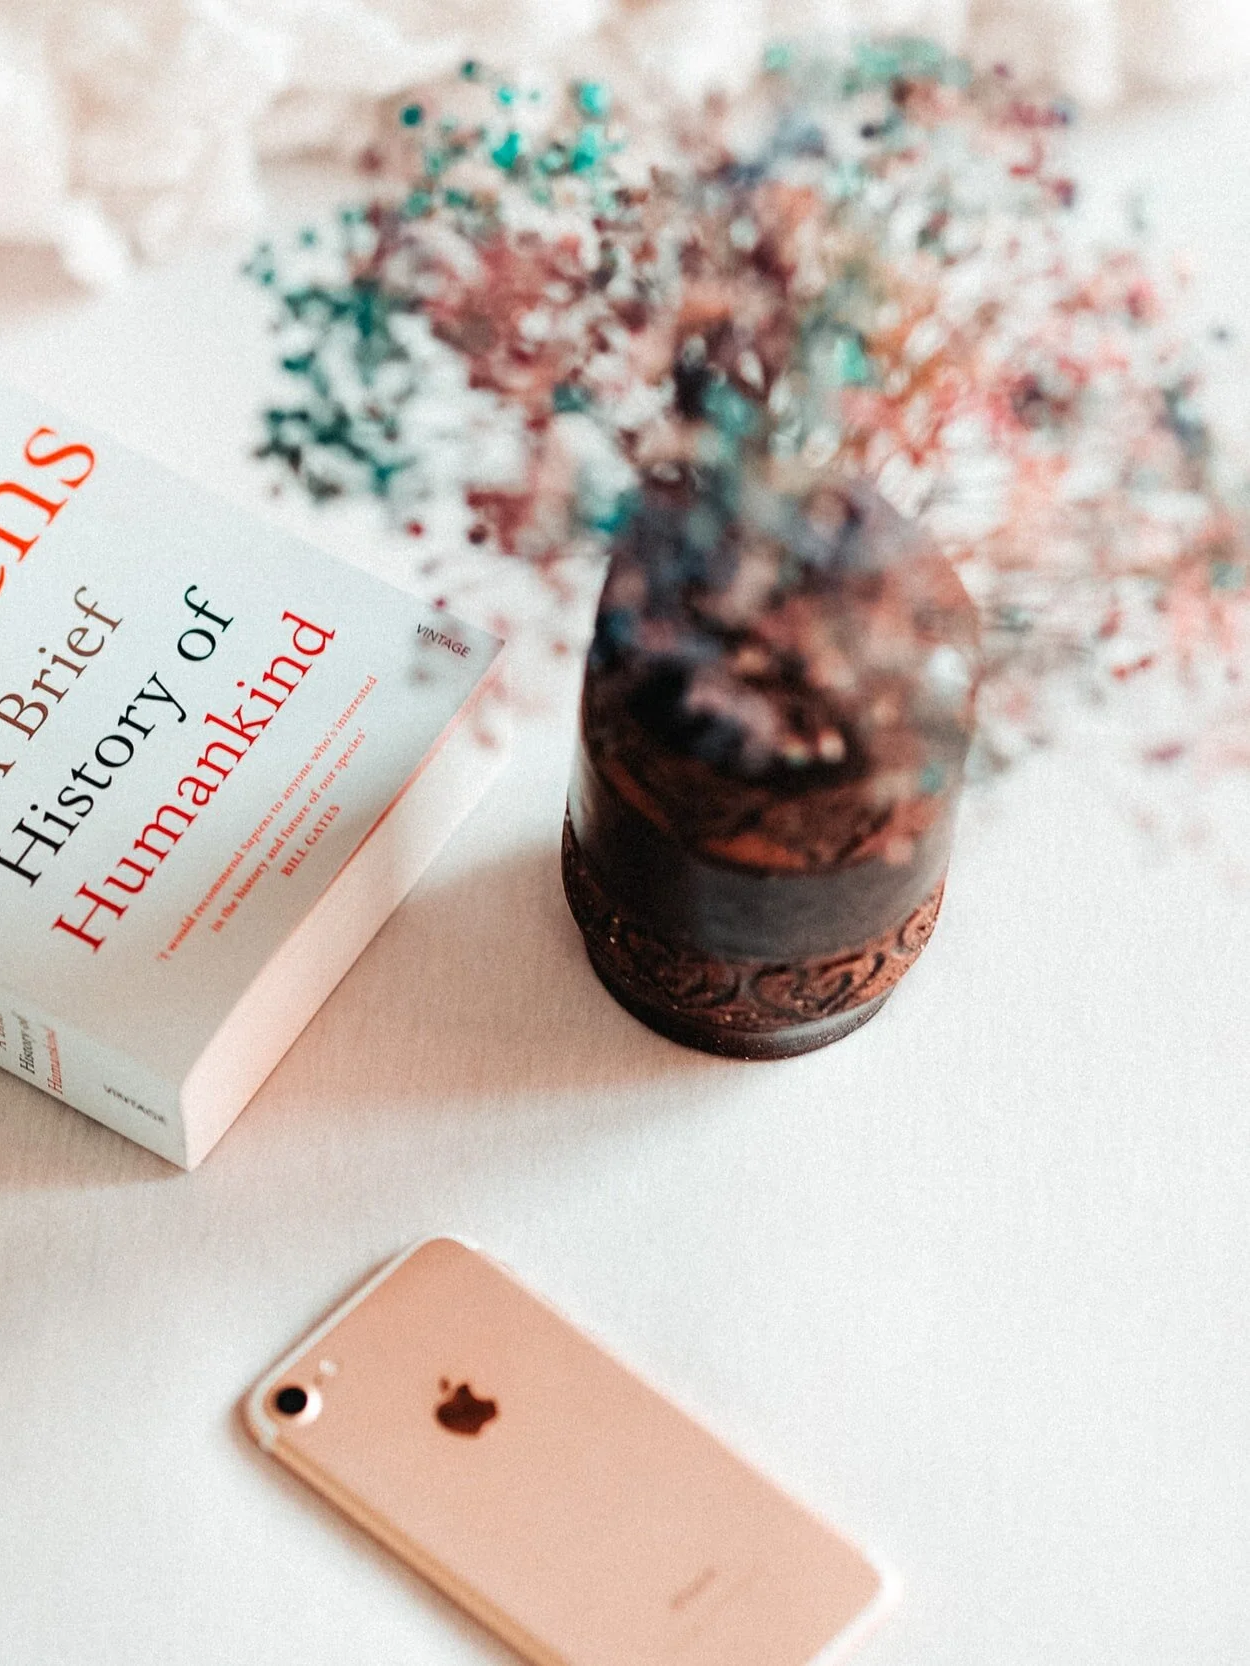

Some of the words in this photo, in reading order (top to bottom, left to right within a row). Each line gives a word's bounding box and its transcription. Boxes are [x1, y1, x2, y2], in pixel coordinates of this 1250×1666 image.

[176, 584, 234, 663] of
[416, 623, 471, 658] VINTAGE
[51, 610, 336, 954] Humankind
[167, 905, 196, 951] would
[194, 851, 245, 916] recommend
[240, 814, 274, 851] Sapiens
[270, 801, 284, 814] to
[283, 762, 313, 801] anyone
[335, 674, 377, 730] interested
[211, 919, 226, 933] in
[221, 900, 239, 918] the
[234, 860, 269, 899] history
[267, 837, 284, 860] and
[280, 805, 310, 838] future
[309, 787, 321, 804] of
[320, 769, 337, 790] our
[280, 849, 307, 877] BILL
[304, 803, 342, 847] GATES
[18, 1030, 36, 1075] History
